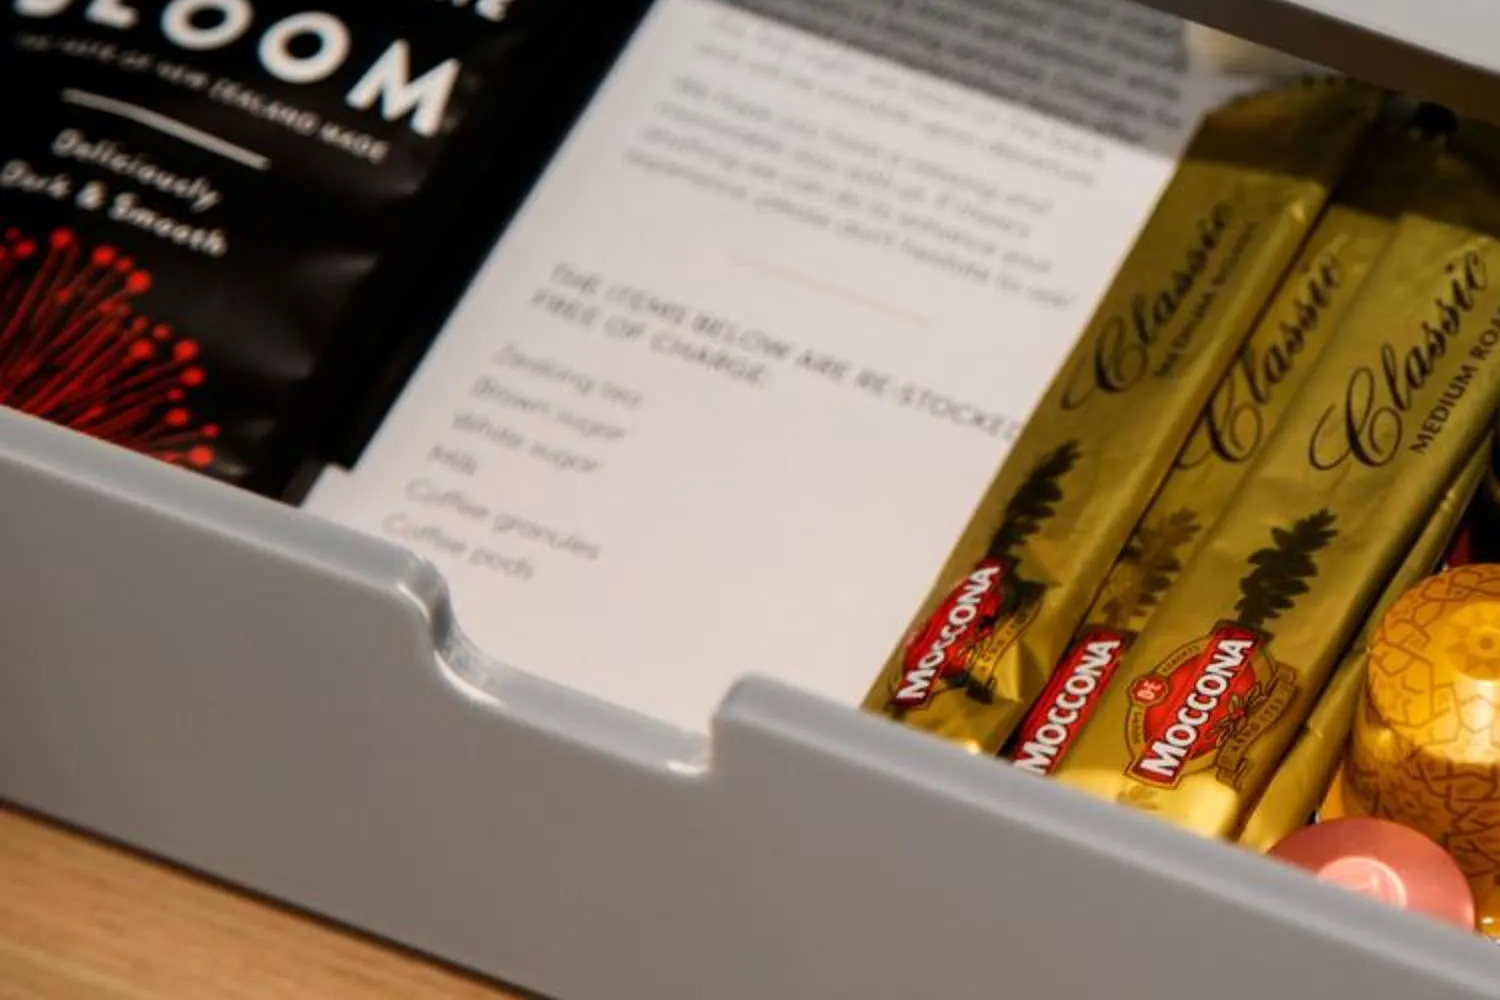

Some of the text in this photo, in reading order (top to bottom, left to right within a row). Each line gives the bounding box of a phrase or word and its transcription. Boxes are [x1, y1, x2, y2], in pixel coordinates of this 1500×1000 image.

[0, 158, 229, 257] Dark & Smooth
[51, 128, 222, 213] Deliciously
[690, 310, 792, 361] BELOW
[1060, 200, 1234, 412] Classic
[1174, 252, 1345, 470] Classic
[1309, 252, 1487, 471] Classic
[1408, 363, 1480, 454] MEDIUM
[1013, 639, 1121, 775] MOCCONA
[1140, 639, 1253, 777] MOCCONA
